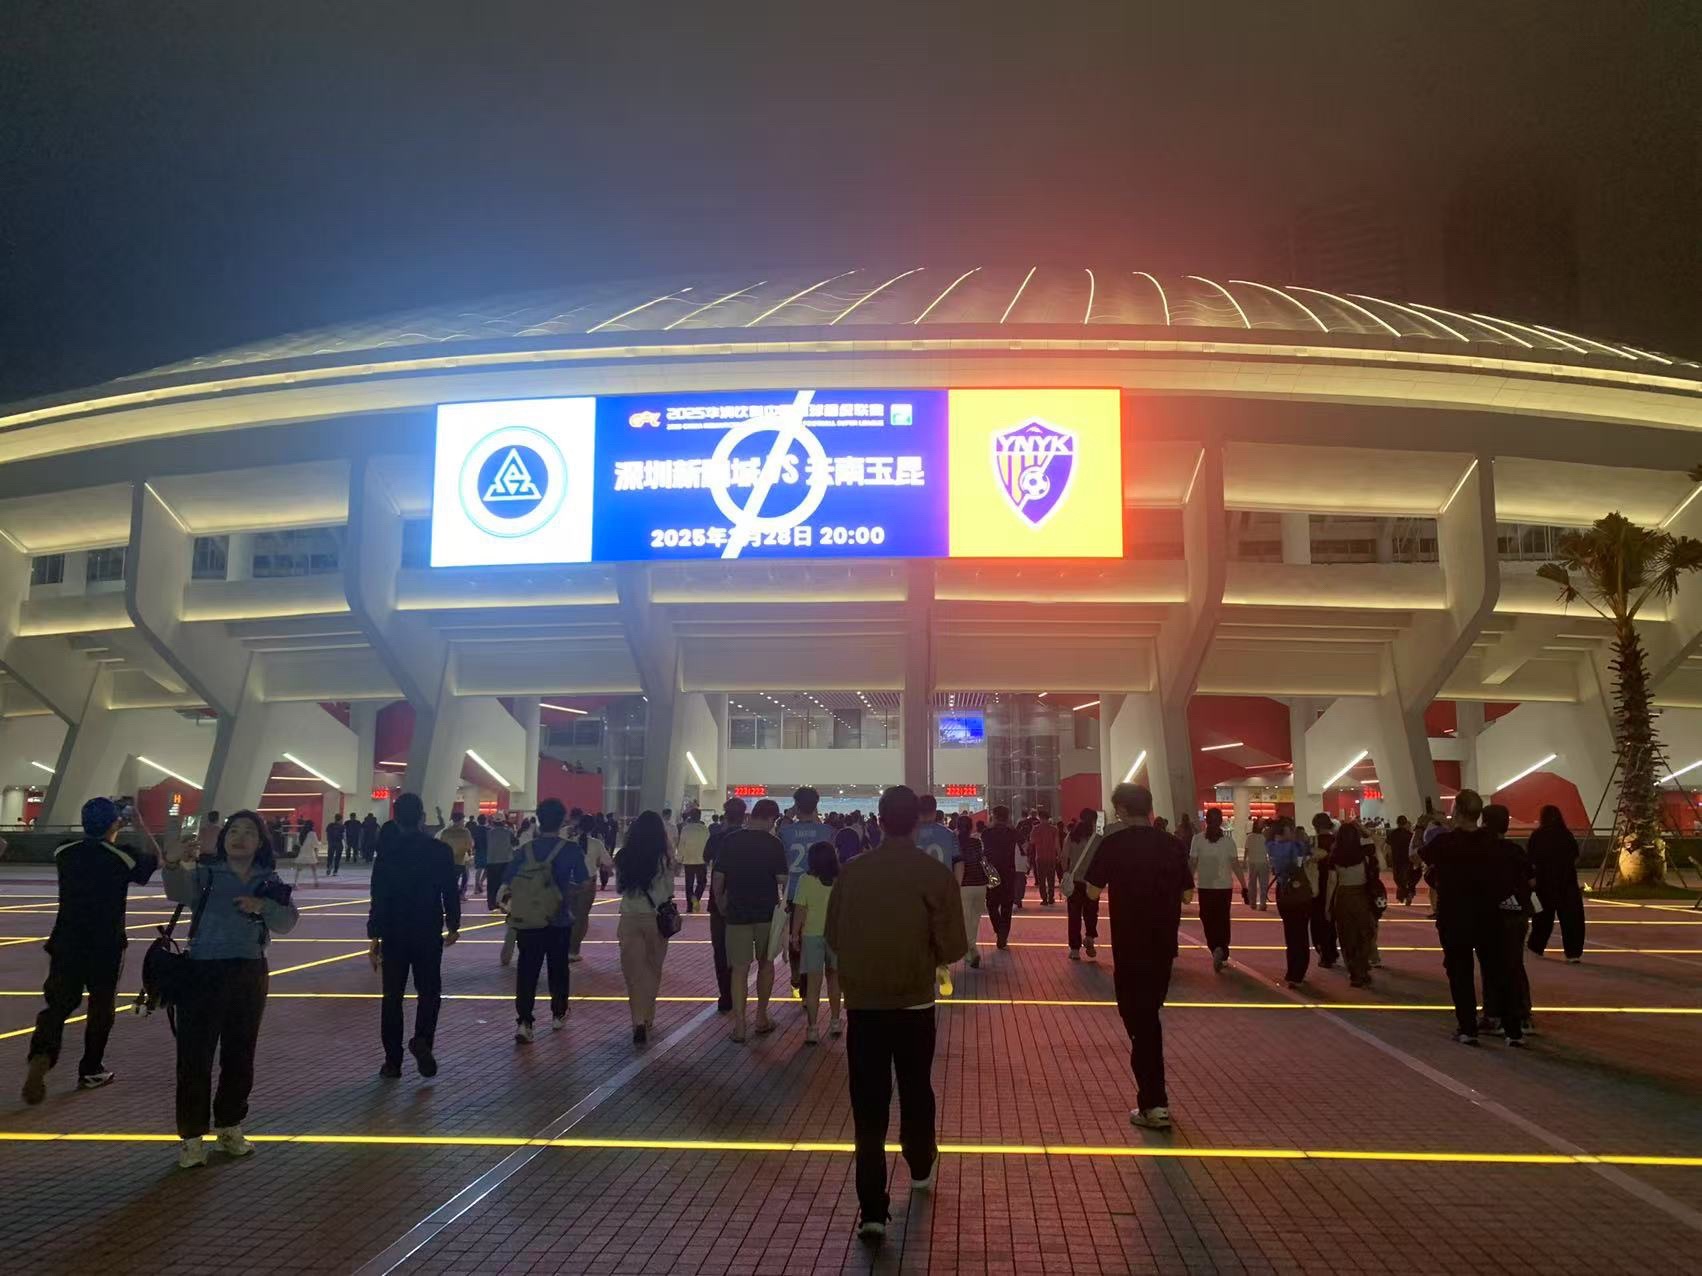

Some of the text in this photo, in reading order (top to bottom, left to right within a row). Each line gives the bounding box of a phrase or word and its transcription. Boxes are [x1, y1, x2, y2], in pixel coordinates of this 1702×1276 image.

[996, 434, 1073, 453] YNYK
[650, 526, 885, 548] 2025年月28日 20:00
